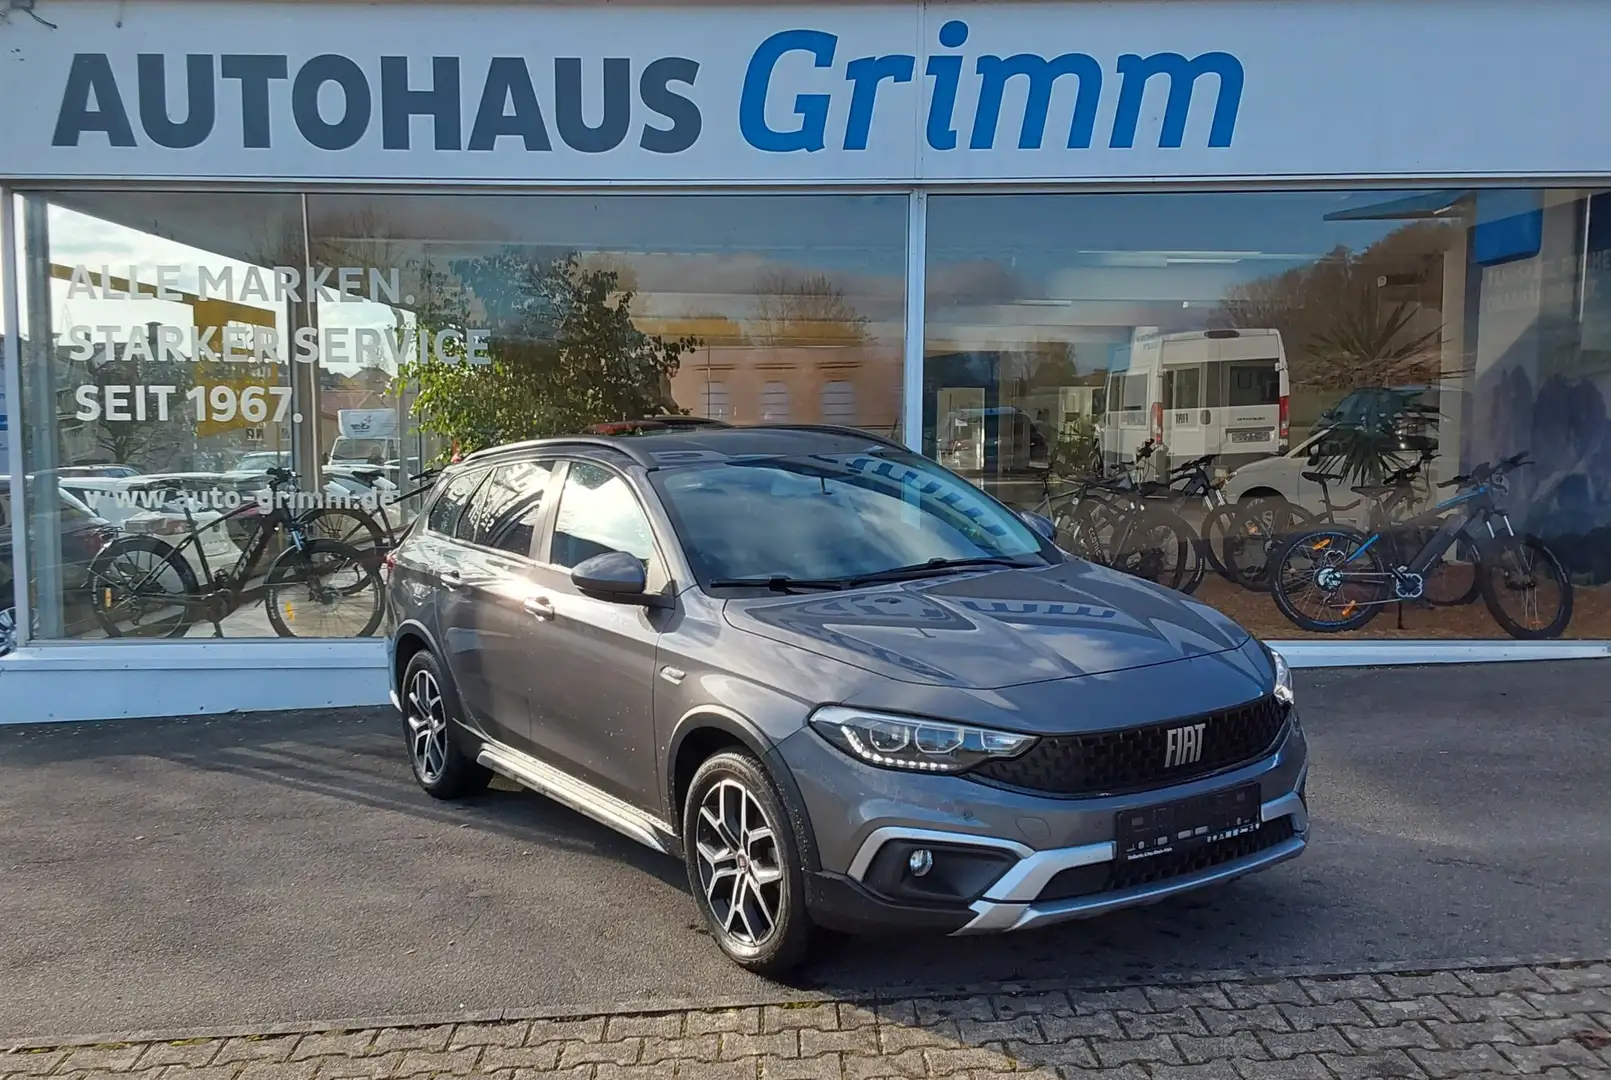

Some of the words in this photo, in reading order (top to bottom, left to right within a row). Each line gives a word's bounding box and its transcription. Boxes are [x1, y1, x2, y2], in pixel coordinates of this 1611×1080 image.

[52, 53, 701, 154] AUTOHAUS
[738, 19, 1245, 153] Grimm
[67, 264, 182, 300] ALLE
[200, 265, 416, 305] MARKEN.
[69, 324, 283, 365] STARKER
[294, 327, 492, 366] SERVICE
[75, 385, 176, 423] SEIT
[186, 385, 304, 424] 1967.
[84, 487, 395, 514] www.auto-grimm.de
[1163, 723, 1206, 768] FIAT
